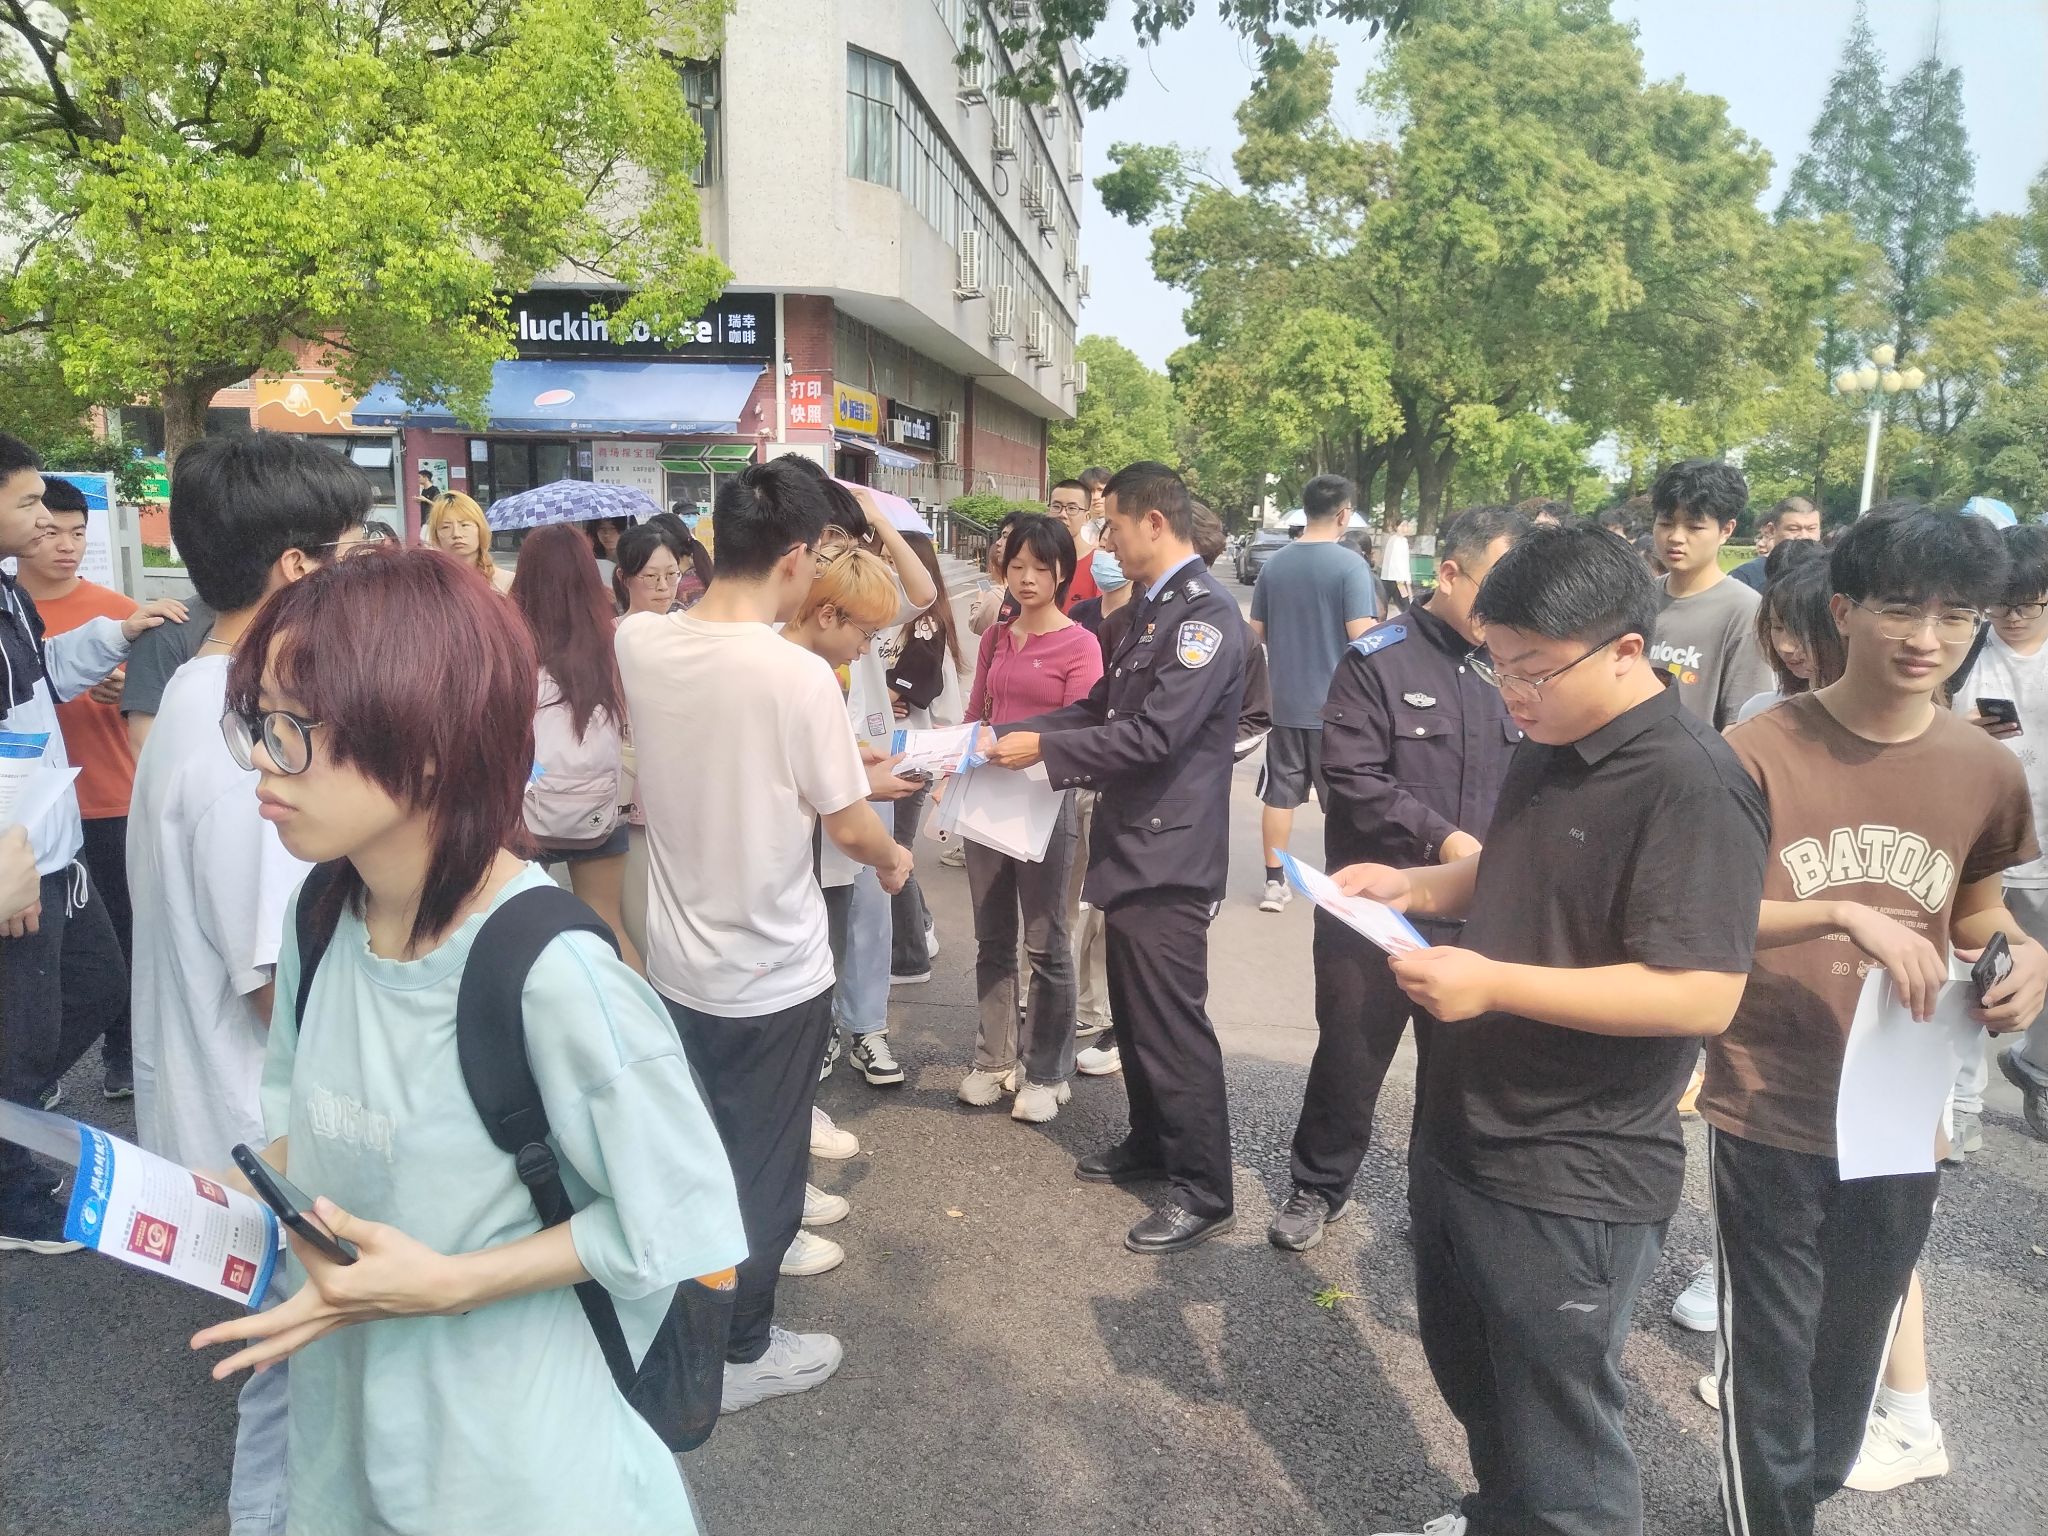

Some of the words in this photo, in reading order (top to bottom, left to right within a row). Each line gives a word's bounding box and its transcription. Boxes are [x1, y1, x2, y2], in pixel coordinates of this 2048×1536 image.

[519, 310, 609, 341] luckin
[727, 314, 756, 329] 瑞幸
[728, 330, 757, 345] 咖啡
[790, 379, 822, 400] 打印
[790, 403, 822, 424] 快照
[1779, 825, 1955, 914] BATON
[1879, 906, 1920, 918] ACKNOWLEDGE
[1916, 922, 1929, 930] ARE
[1831, 961, 1850, 976] 20
